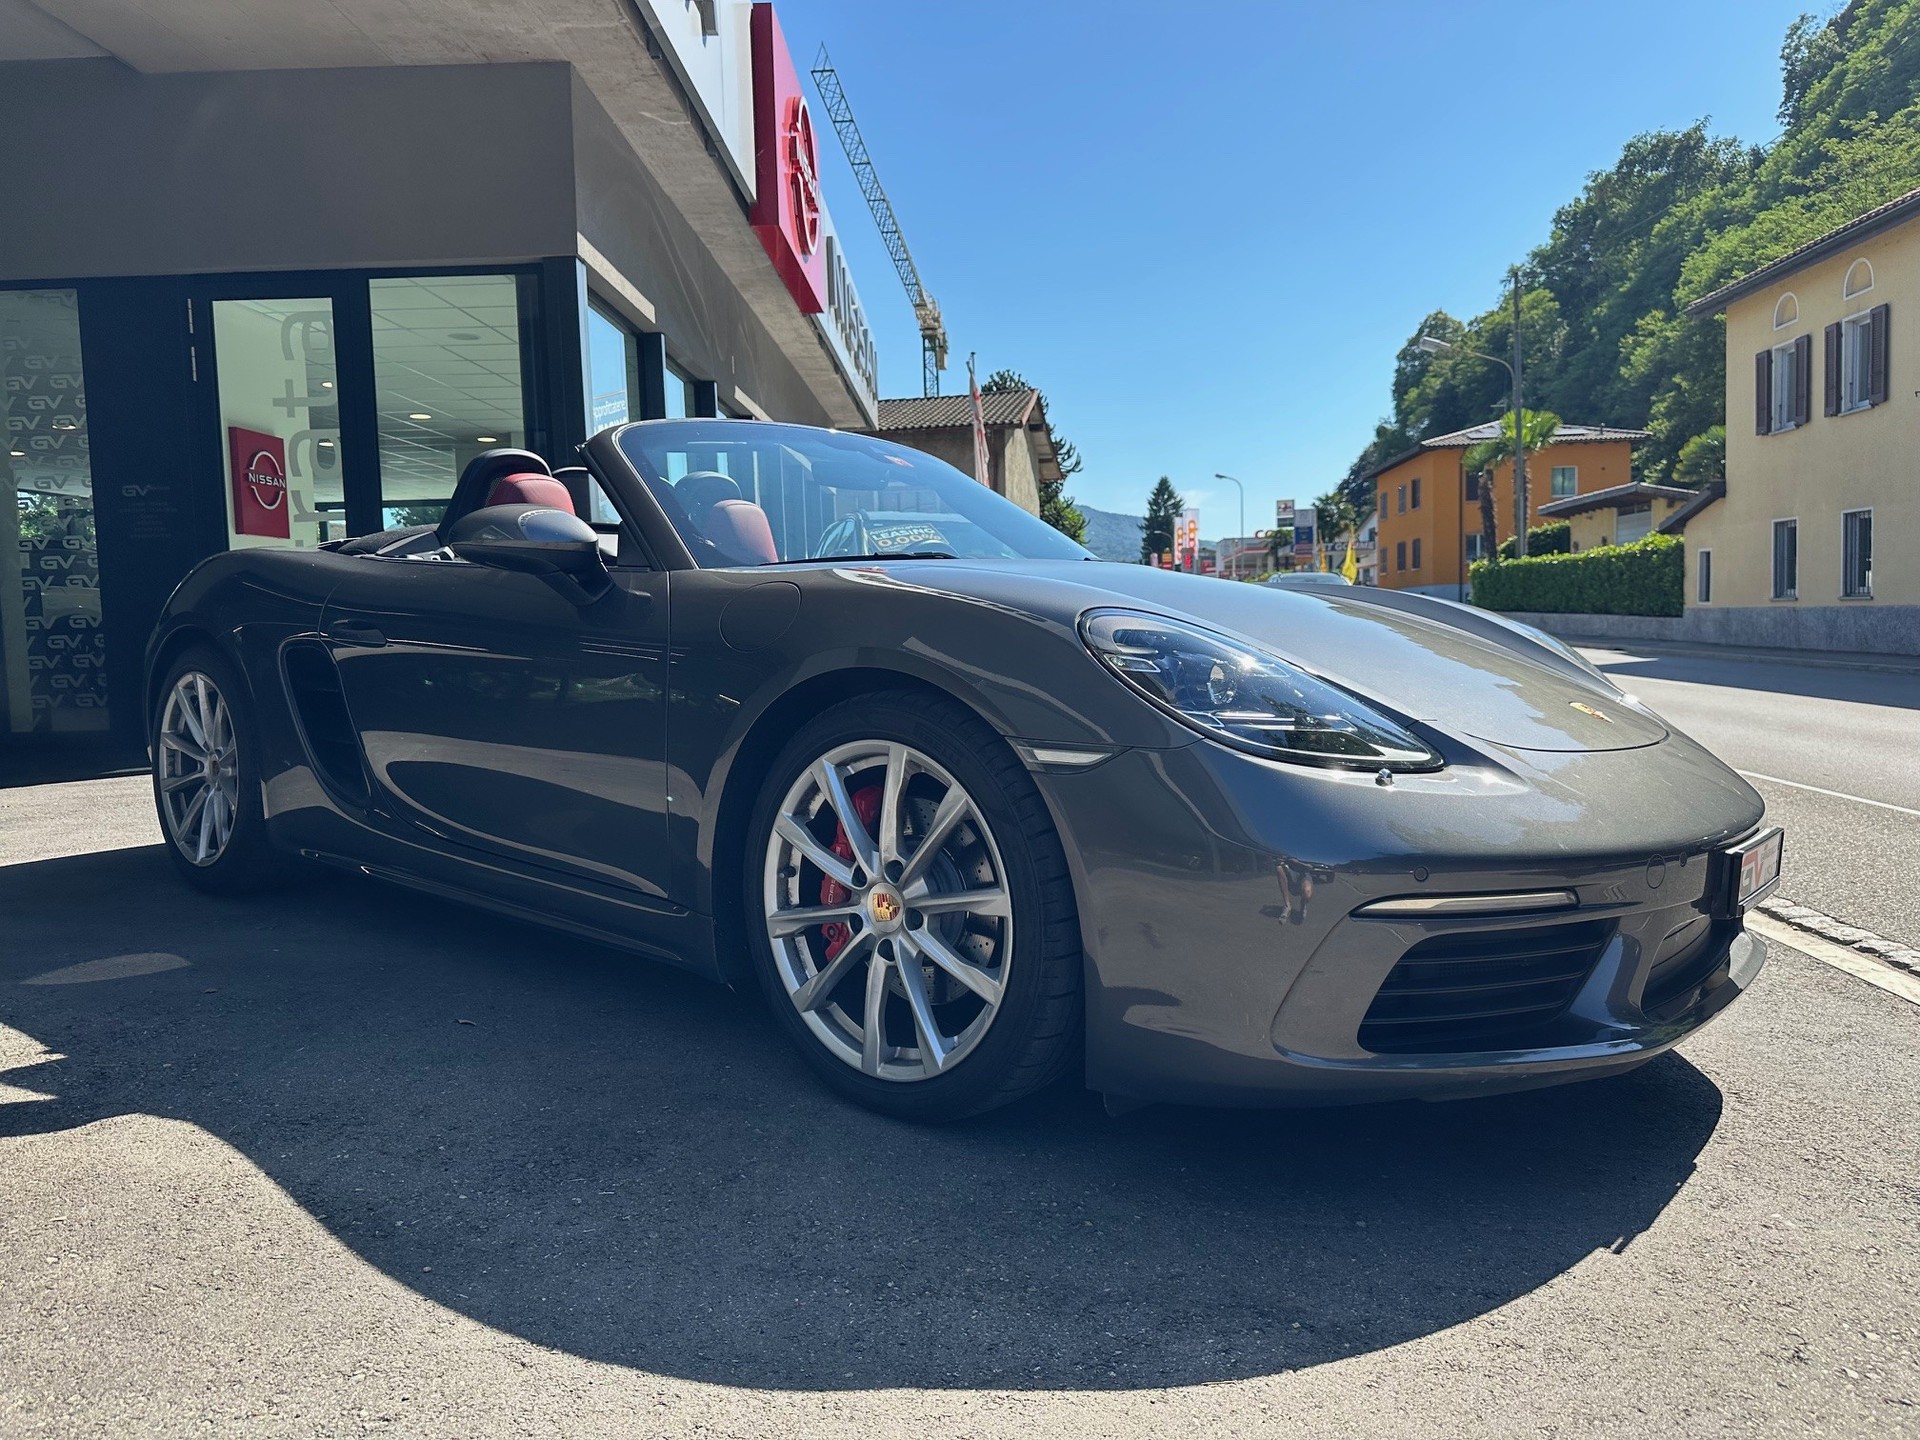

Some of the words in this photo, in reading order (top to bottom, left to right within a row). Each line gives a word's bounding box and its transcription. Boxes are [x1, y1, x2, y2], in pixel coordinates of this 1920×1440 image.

[27, 395, 63, 409] GV
[8, 416, 41, 430] GV
[30, 436, 66, 449] GV
[34, 475, 69, 489] GV
[248, 472, 286, 488] NISSAN
[122, 484, 151, 497] GV
[872, 528, 935, 541] LEASING
[878, 533, 942, 547] 0.00%
[19, 537, 50, 550] GV
[40, 555, 76, 569] GV
[65, 575, 99, 588] GV
[25, 616, 57, 630] GV
[69, 615, 102, 628] GV
[47, 634, 83, 649] GV
[29, 655, 62, 669] GV
[72, 653, 105, 668] GV
[51, 674, 87, 688] GV
